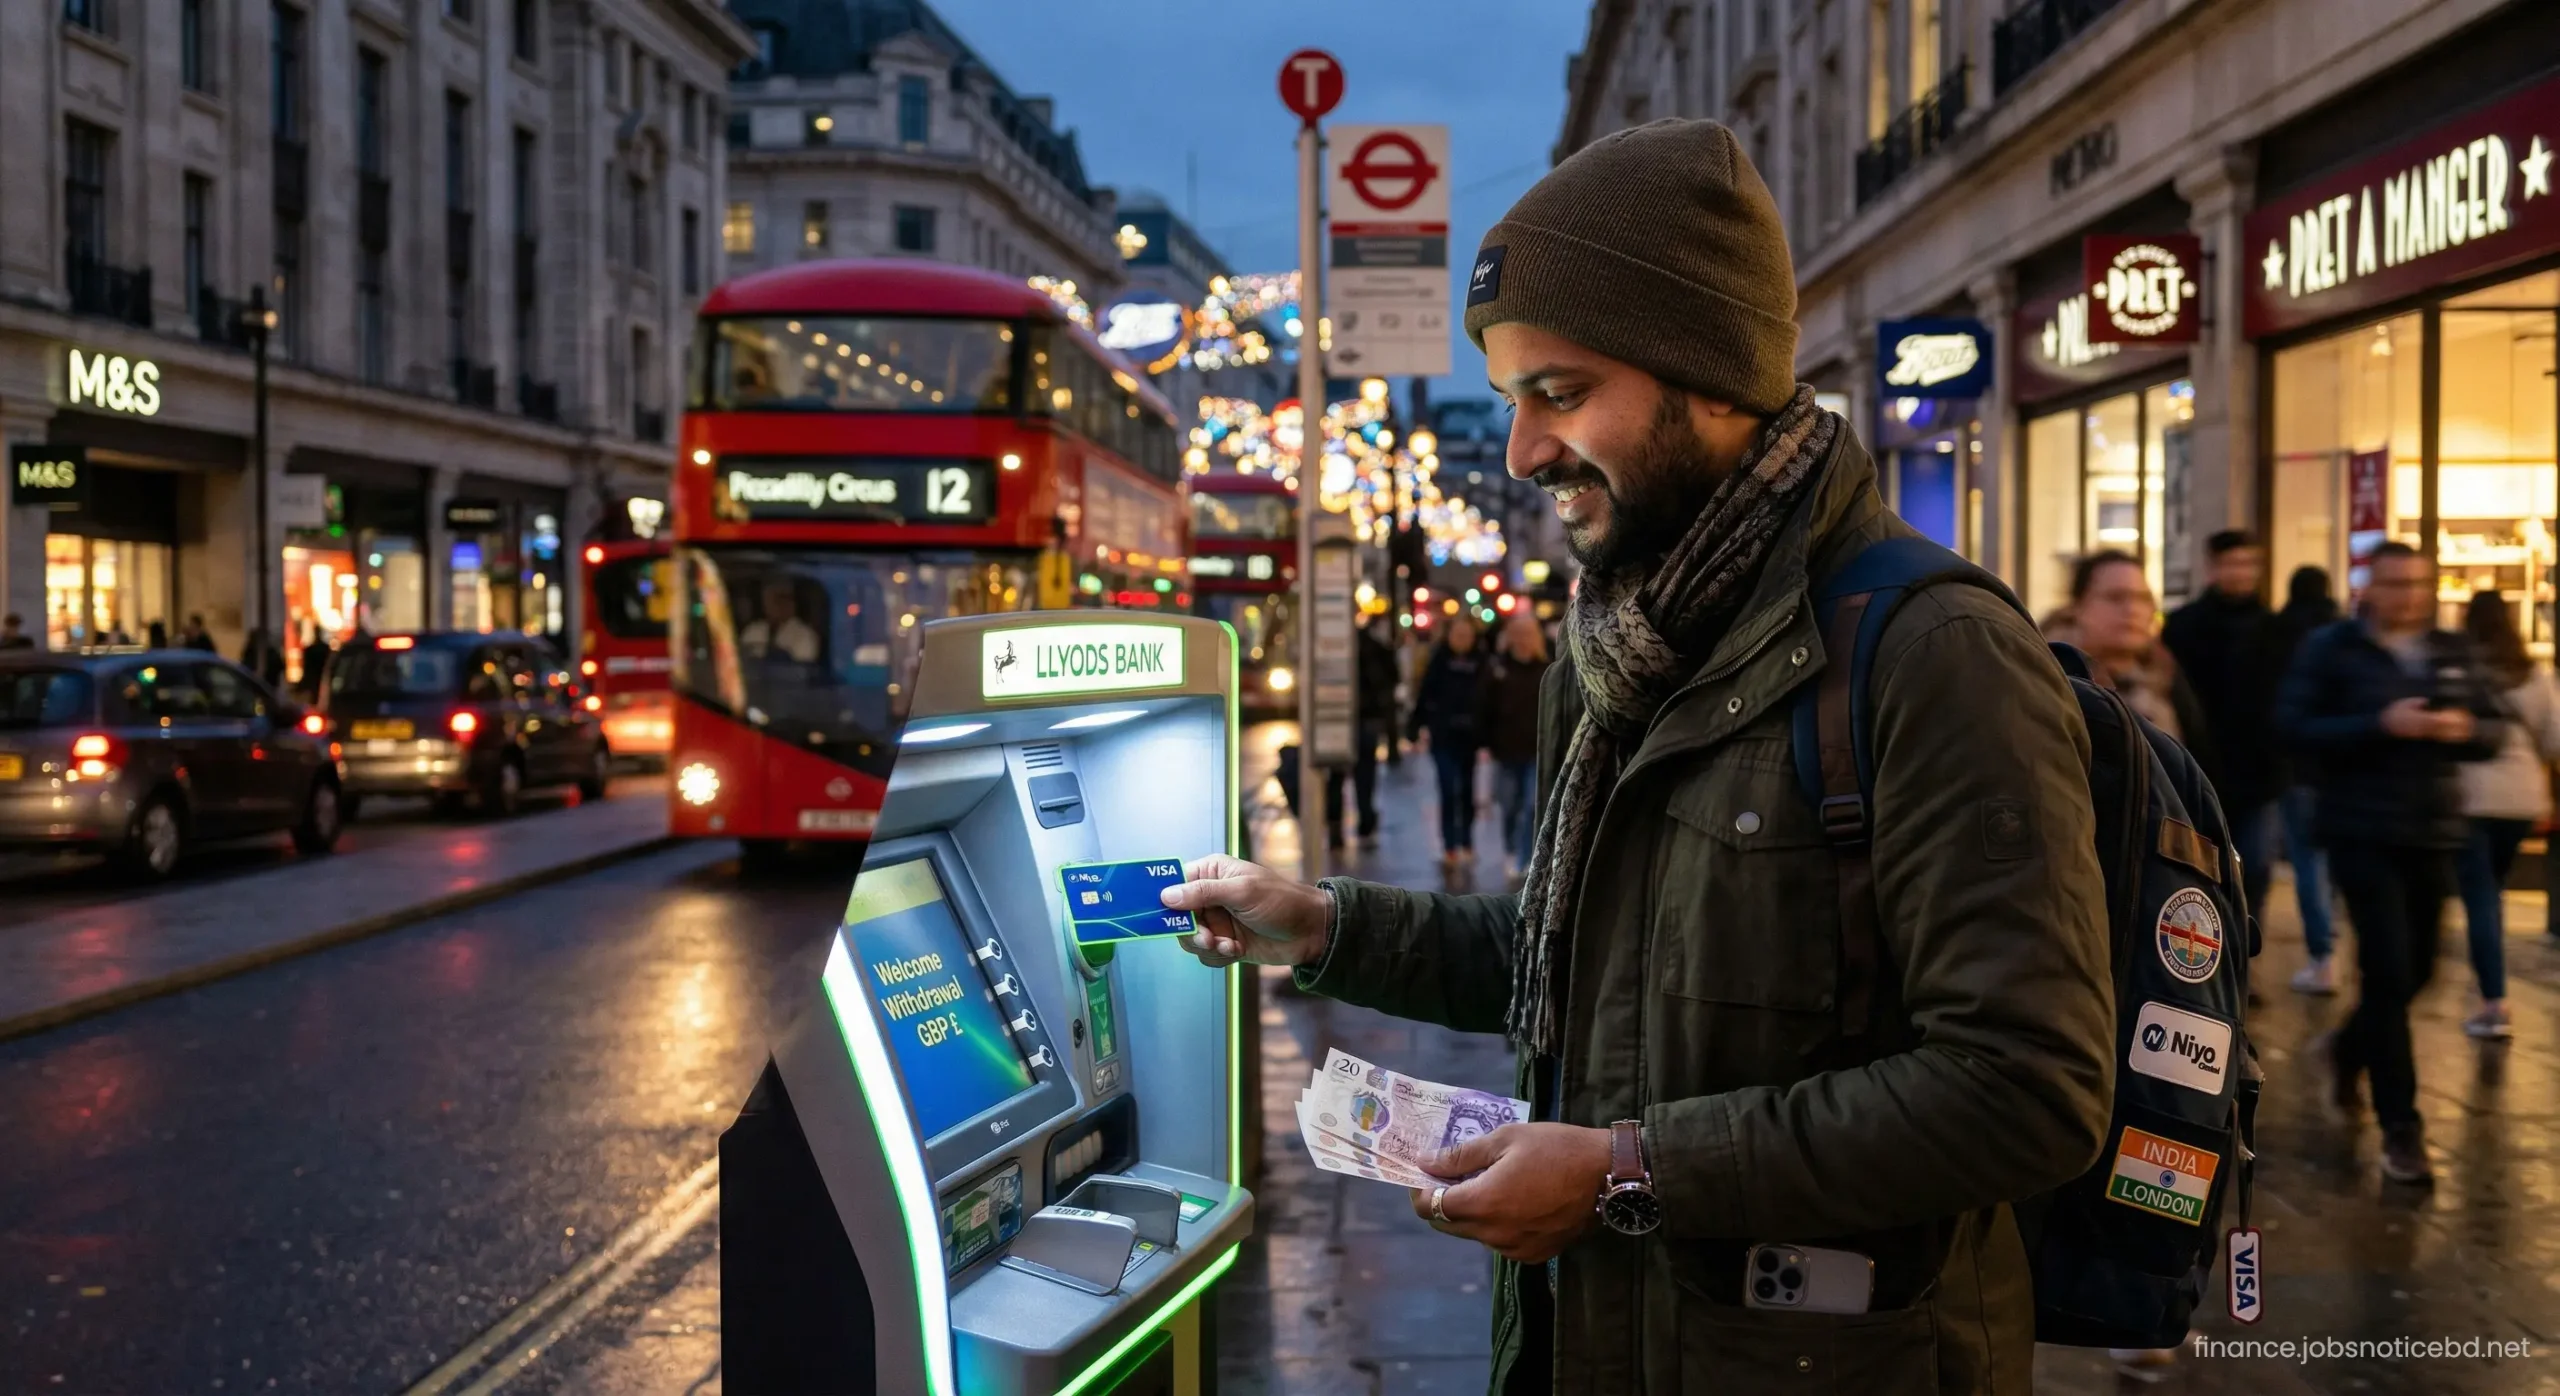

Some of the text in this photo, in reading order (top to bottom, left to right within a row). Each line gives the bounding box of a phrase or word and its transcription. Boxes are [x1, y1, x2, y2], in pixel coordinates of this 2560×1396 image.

[1291, 57, 1330, 108] T
[2289, 134, 2508, 299] PRET A MANGER
[2107, 266, 2185, 313] PRET
[69, 349, 160, 416] M&S
[19, 460, 76, 489] M&S
[926, 468, 972, 514] 12
[1036, 642, 1165, 679] LLYODS BANK
[1145, 864, 1178, 877] VISA
[1161, 916, 1190, 927] VISA
[873, 952, 943, 987] Welcome
[881, 974, 965, 1022] Withdrawal
[916, 1017, 949, 1048] GBP
[2170, 1031, 2216, 1063] Niyo
[2142, 1140, 2197, 1175] INDIA
[2121, 1180, 2195, 1217] LONDON
[2235, 1241, 2256, 1312] VISA
